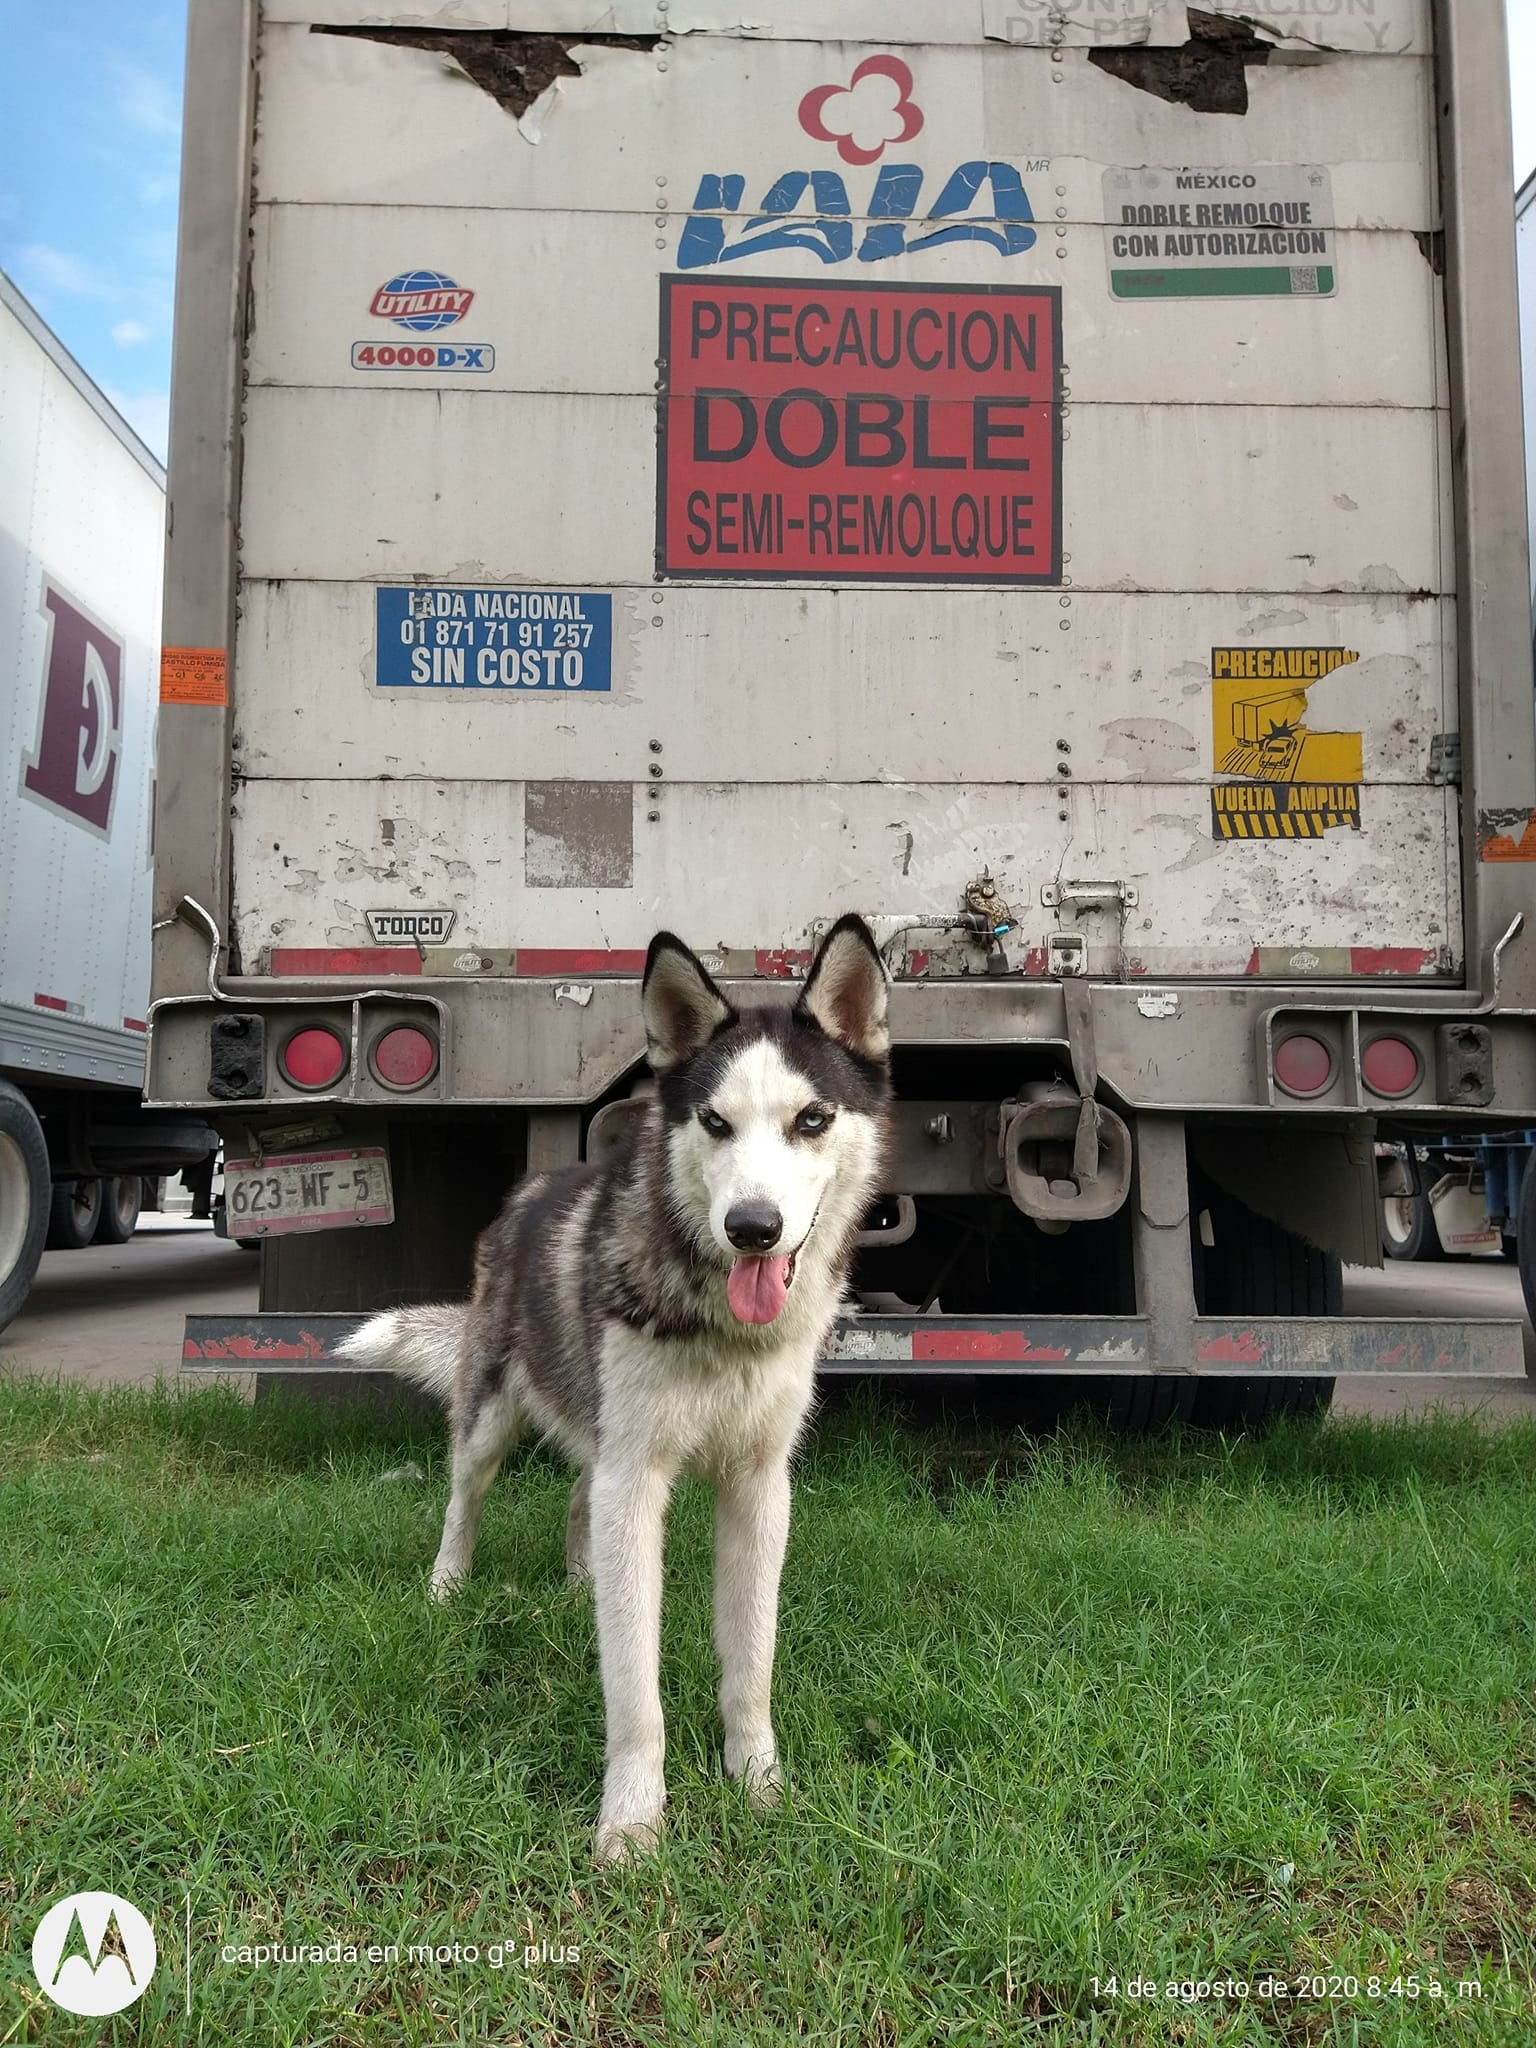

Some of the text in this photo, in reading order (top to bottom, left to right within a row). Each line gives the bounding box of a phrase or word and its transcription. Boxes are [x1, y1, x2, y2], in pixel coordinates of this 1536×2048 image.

[1364, 21, 1390, 48] Y
[1026, 160, 1050, 172] MR
[1176, 173, 1257, 189] MÉXICO
[1121, 202, 1312, 226] DOBLE REMOLQUE
[1112, 234, 1159, 257] CON
[375, 292, 469, 314] UTILITY
[690, 300, 1036, 372] PRECAUCION
[693, 386, 1031, 471] DOBLE
[687, 490, 1035, 558] SEMI-REMOLQUE
[475, 593, 585, 620] NACIONAL
[401, 619, 593, 648] 01 871 71 91 257
[411, 647, 582, 687] SIN COSTO
[1214, 786, 1357, 812] VUELTA AMPLIA
[374, 916, 443, 935] TODCO
